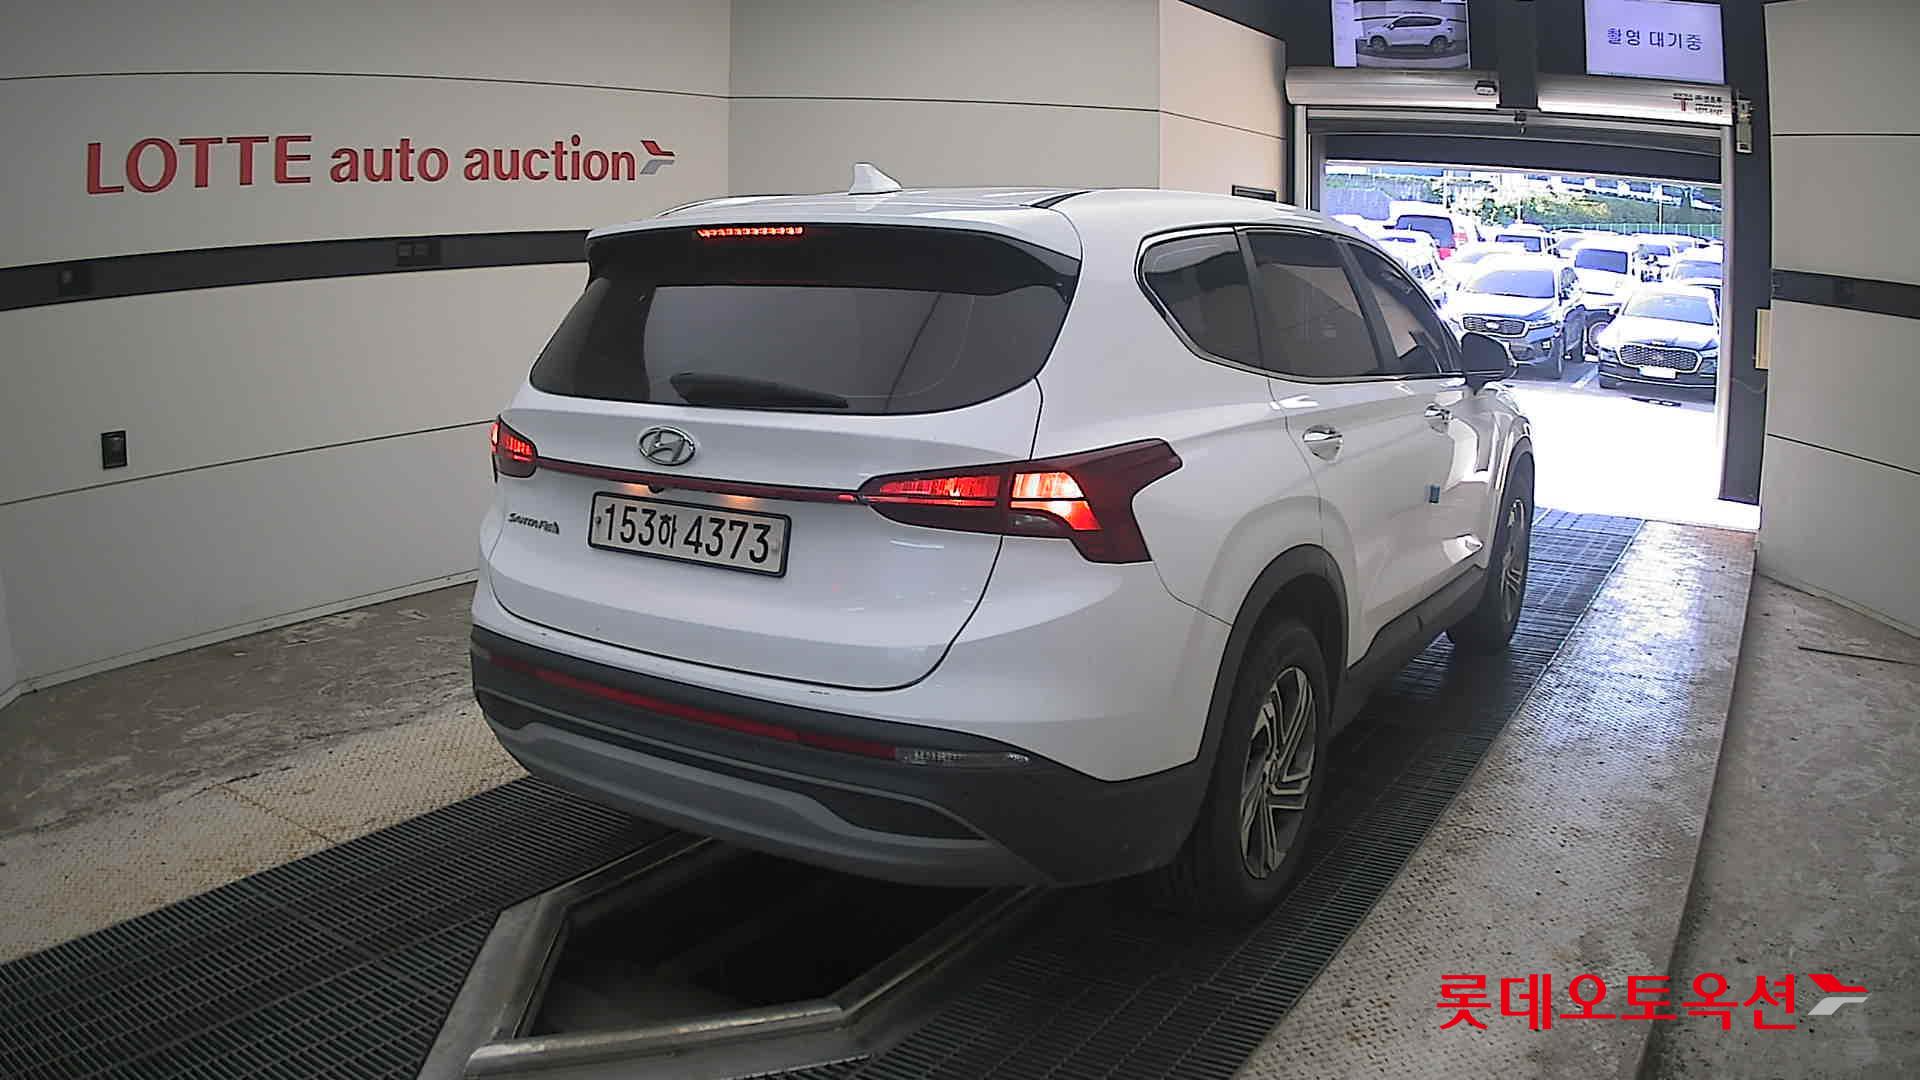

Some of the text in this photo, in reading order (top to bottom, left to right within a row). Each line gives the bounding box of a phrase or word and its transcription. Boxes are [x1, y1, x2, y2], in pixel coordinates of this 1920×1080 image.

[86, 134, 637, 195] LOTTE auto auction
[604, 503, 772, 564] 153하 4373
